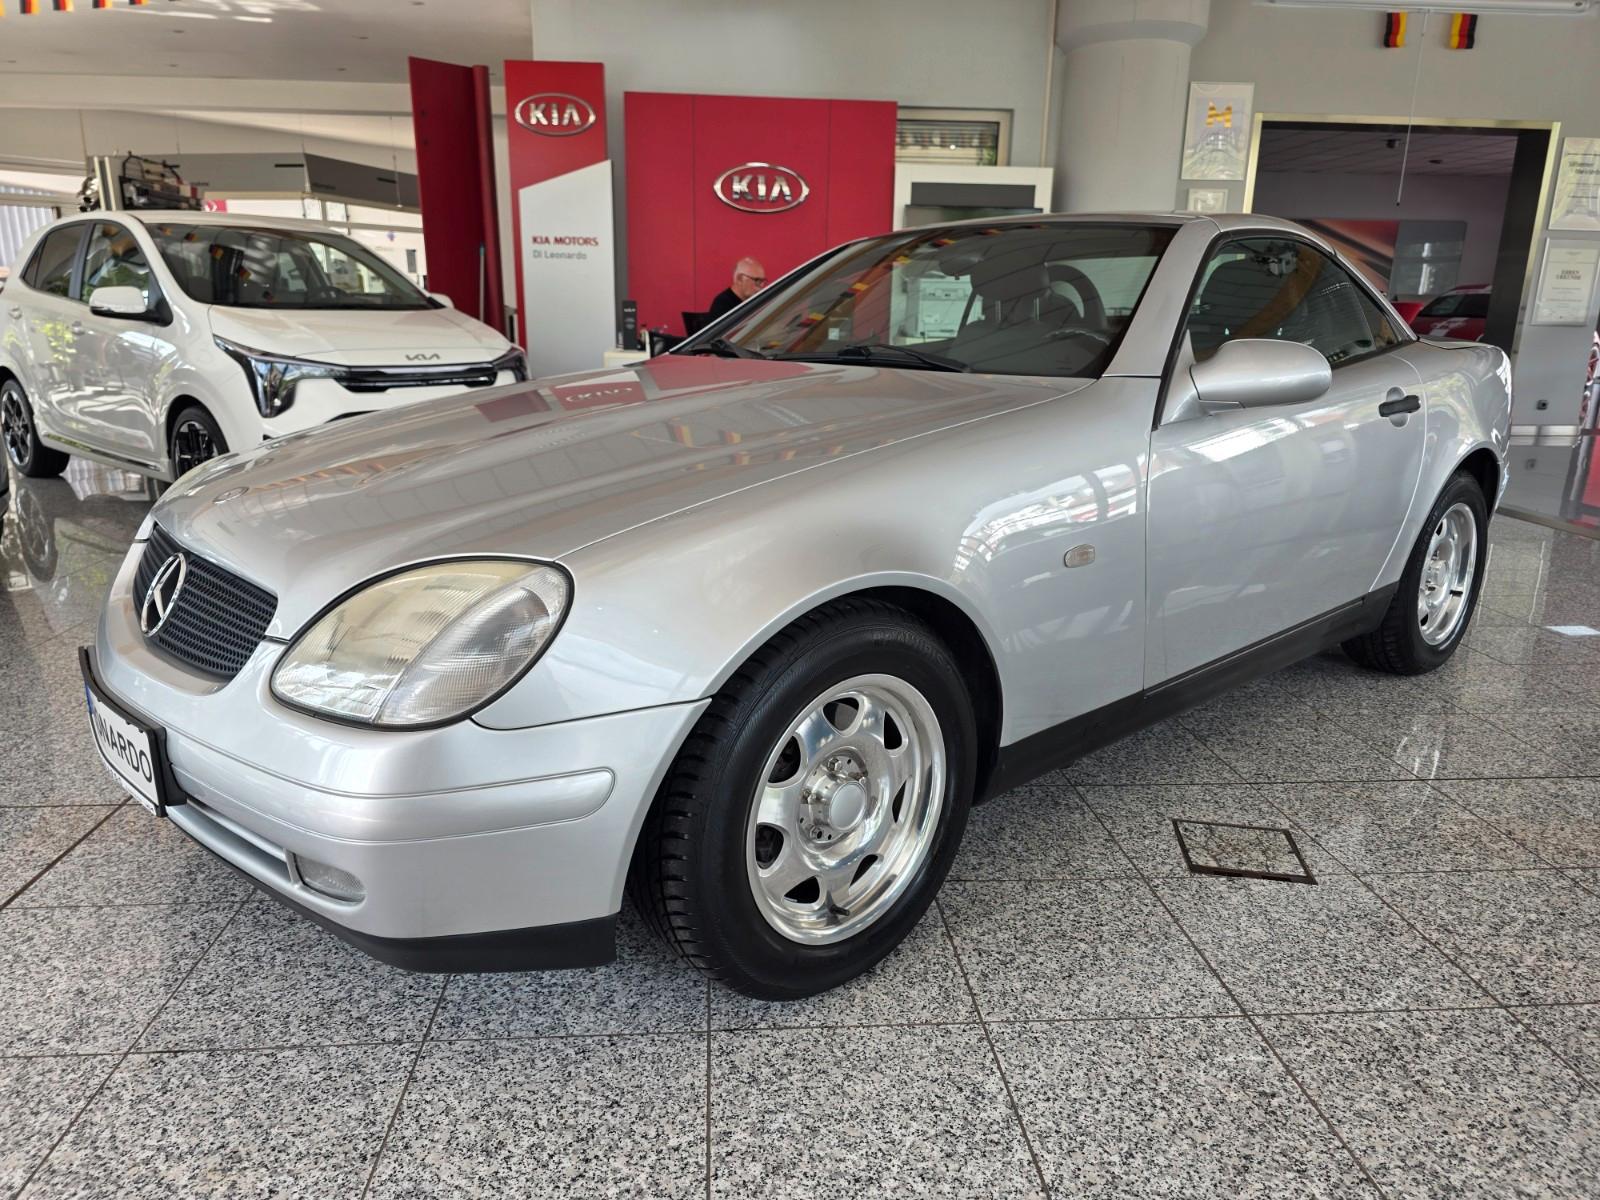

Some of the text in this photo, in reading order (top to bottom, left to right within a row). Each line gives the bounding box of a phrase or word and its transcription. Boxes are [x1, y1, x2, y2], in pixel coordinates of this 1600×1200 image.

[529, 103, 581, 126] KIA
[732, 175, 792, 201] KIA
[532, 236, 599, 247] KIA MOTORS
[543, 250, 588, 260] Leonardo
[405, 353, 441, 361] KIA
